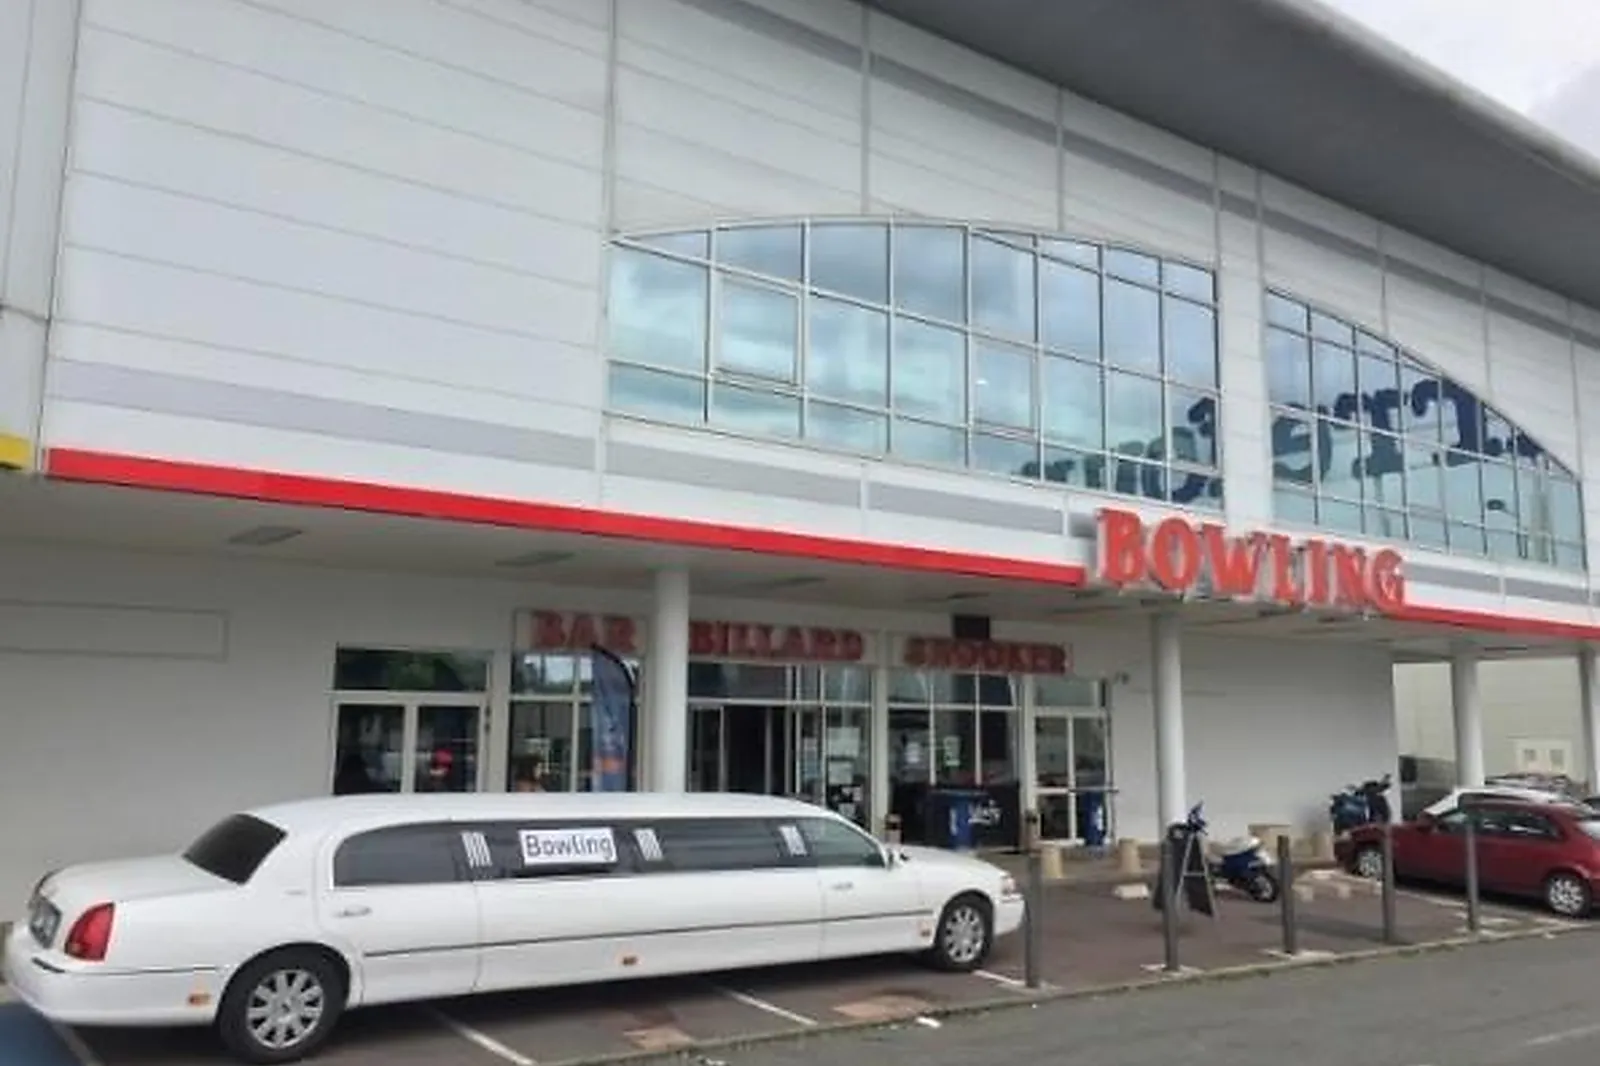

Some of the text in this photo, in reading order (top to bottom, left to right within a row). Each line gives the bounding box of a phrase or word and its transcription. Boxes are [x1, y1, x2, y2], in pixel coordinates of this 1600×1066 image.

[1097, 507, 1406, 610] BOWLING
[532, 610, 638, 653] BAR
[688, 620, 864, 661] BILLARD
[525, 833, 612, 860] Bowling
